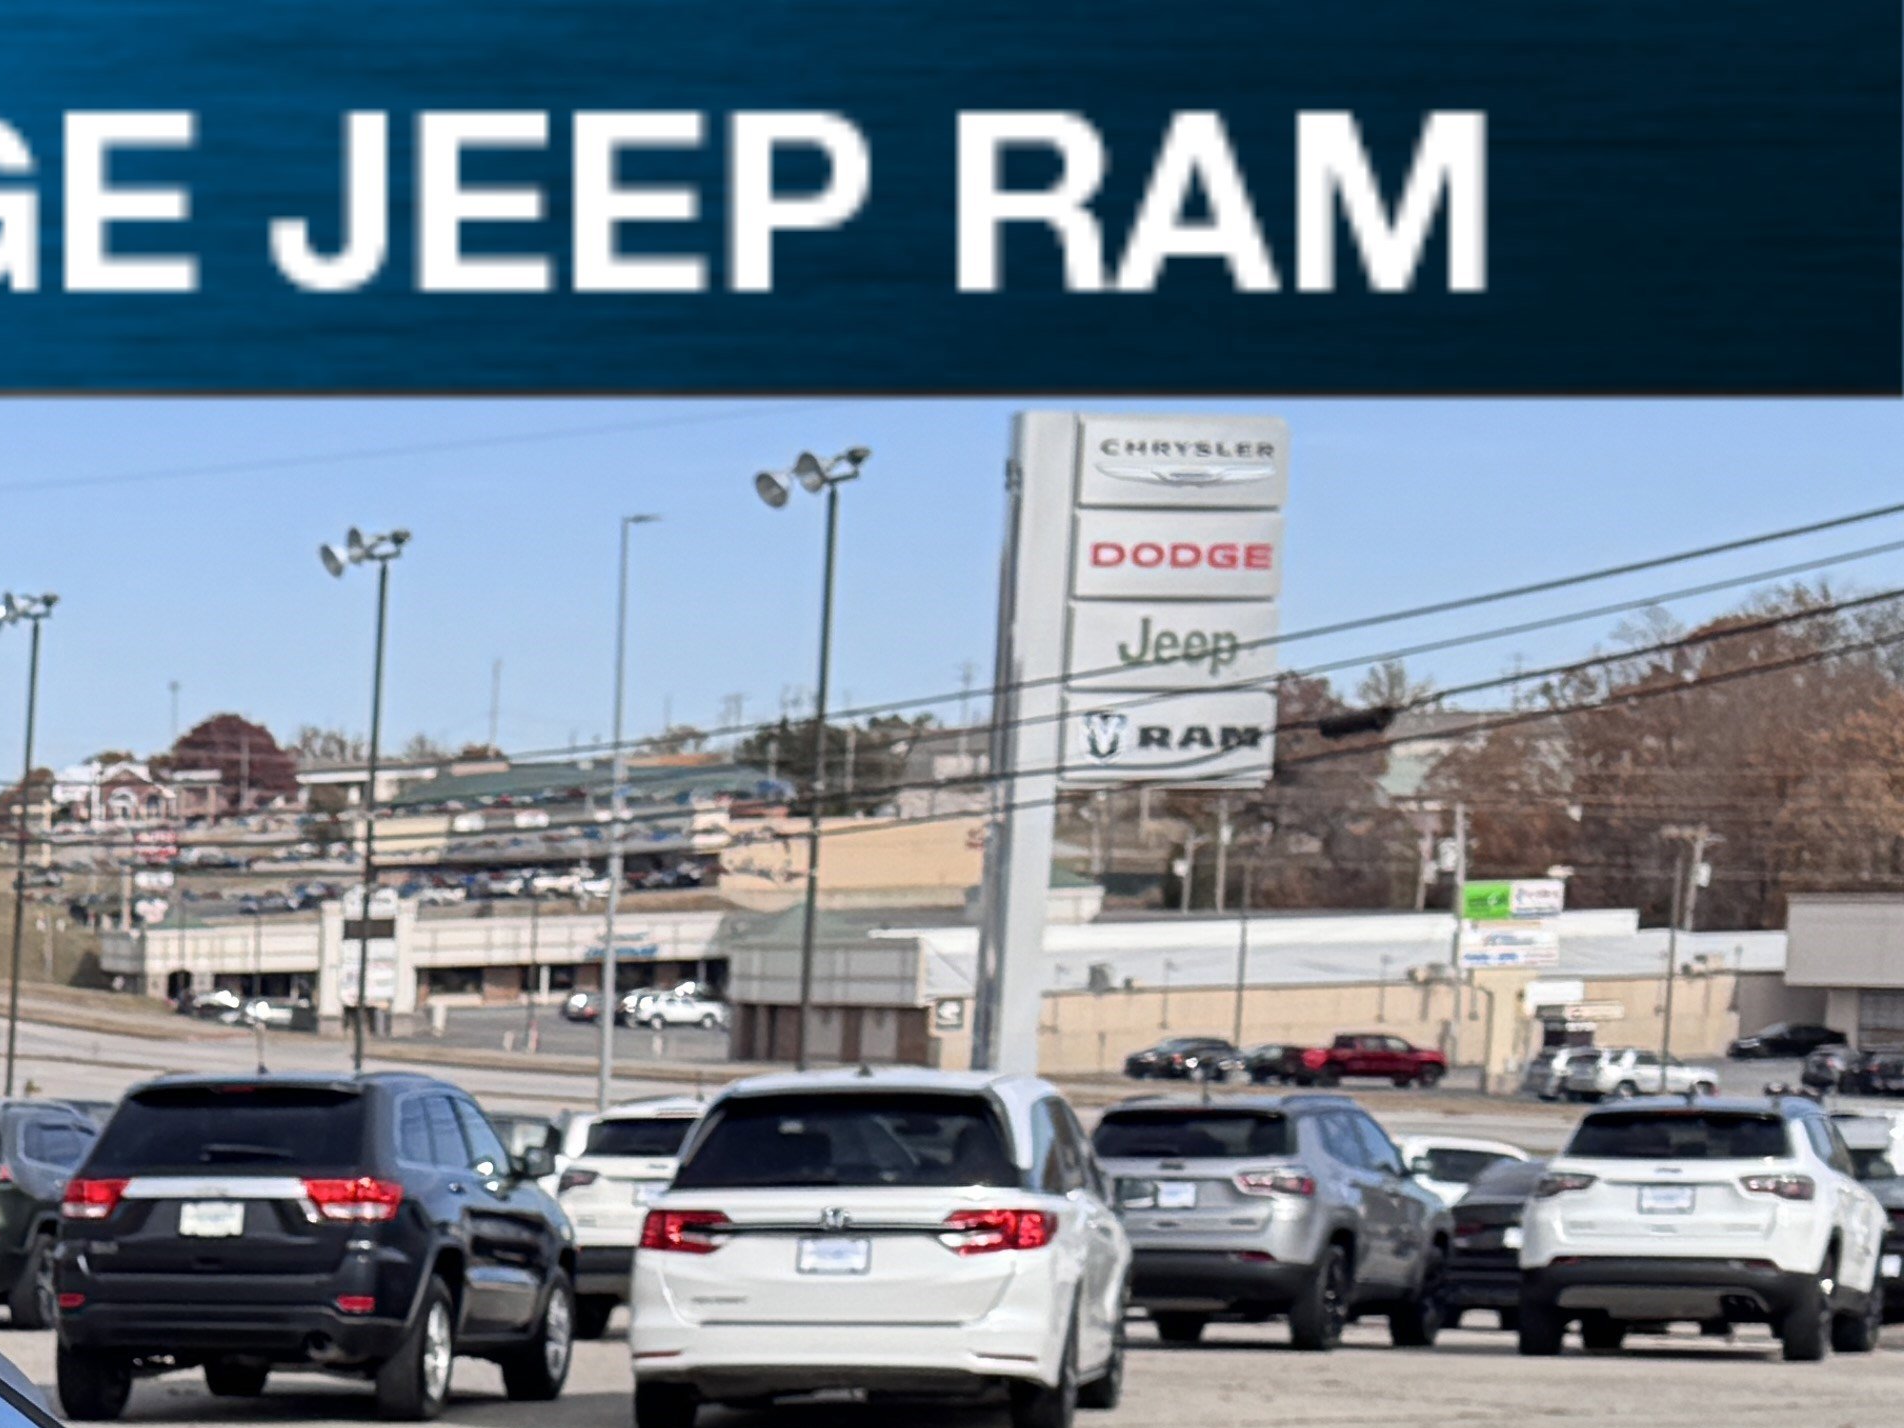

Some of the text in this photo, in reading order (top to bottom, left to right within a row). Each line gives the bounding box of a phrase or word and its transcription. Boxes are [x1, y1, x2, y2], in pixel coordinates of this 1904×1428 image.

[1100, 437, 1276, 459] CHRYSLER
[1089, 541, 1273, 570] DODGE
[1118, 617, 1241, 676] Jeep
[1137, 723, 1266, 750] RAM
